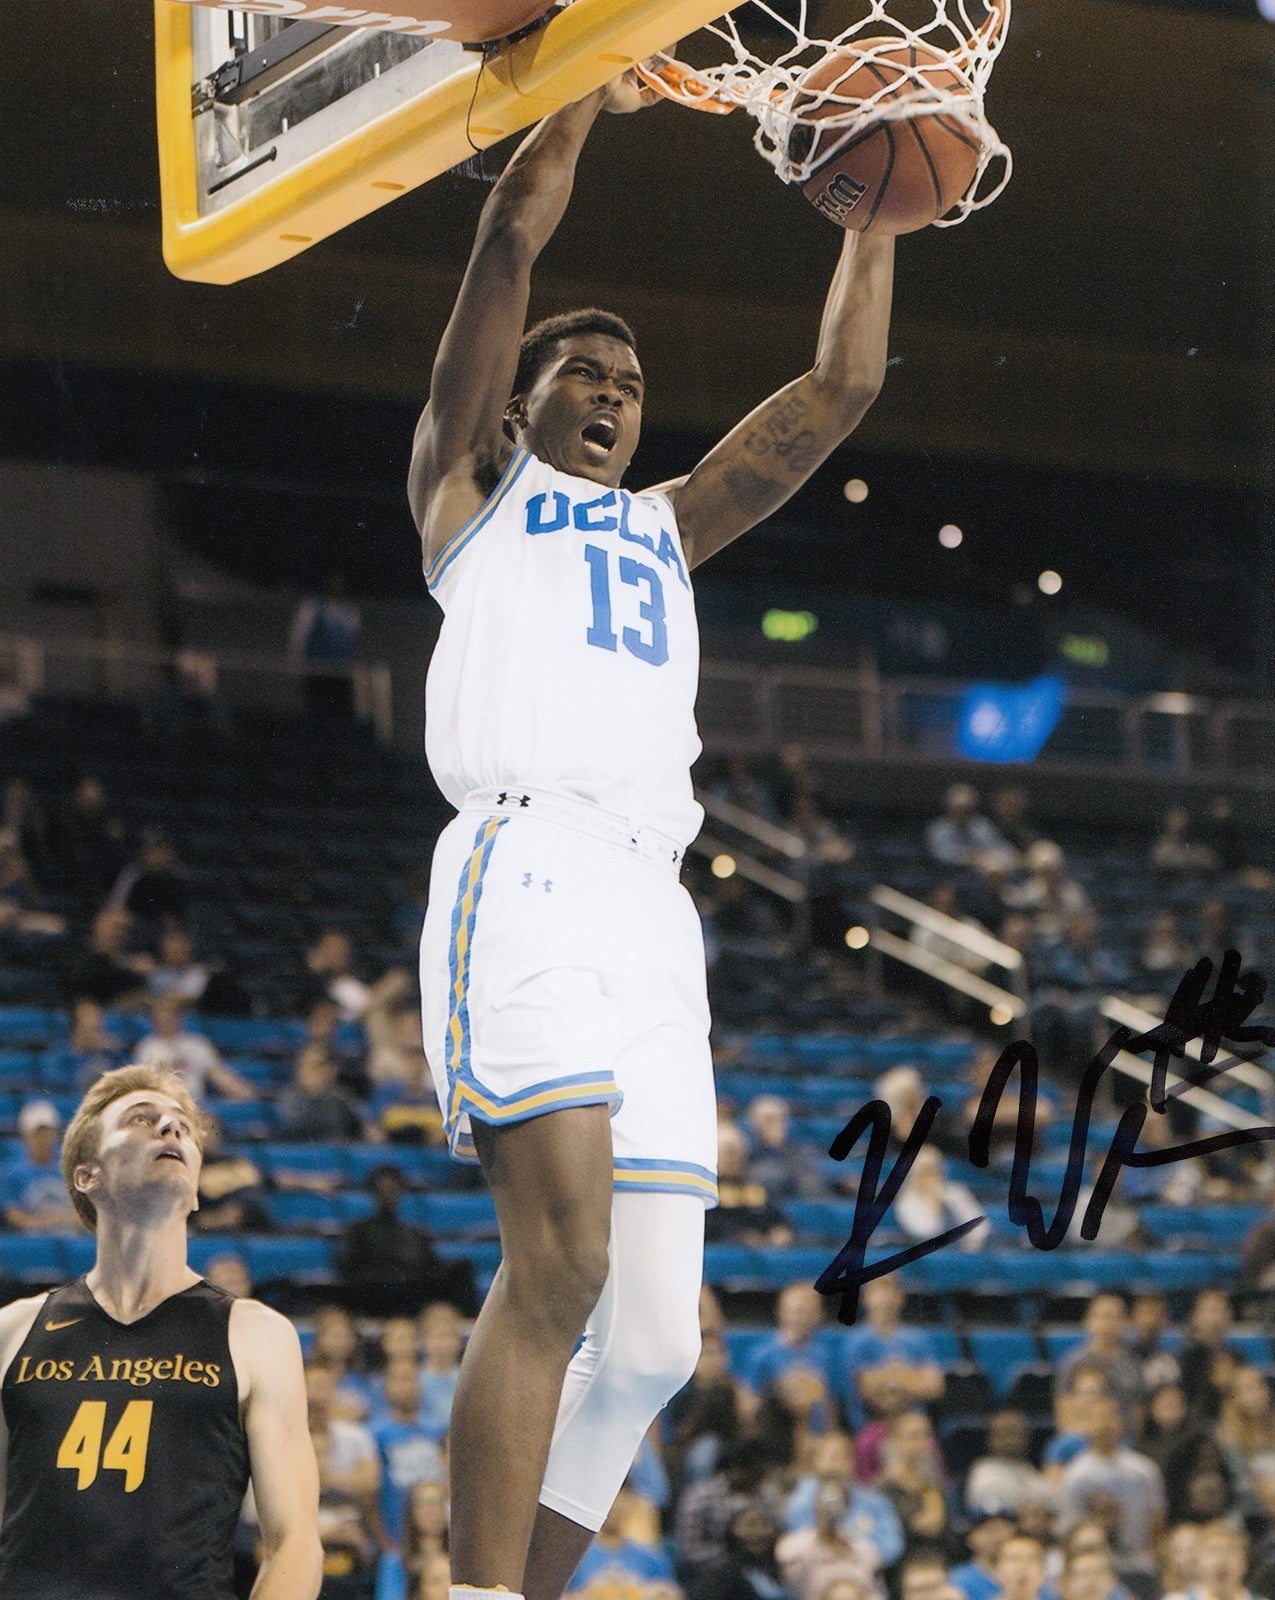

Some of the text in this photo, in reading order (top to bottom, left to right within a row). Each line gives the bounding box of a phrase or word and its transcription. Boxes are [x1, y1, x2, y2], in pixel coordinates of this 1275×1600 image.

[525, 490, 690, 591] UCLA
[584, 543, 669, 667] 13
[15, 1354, 221, 1388] Los Angeles
[56, 1400, 154, 1493] 44
